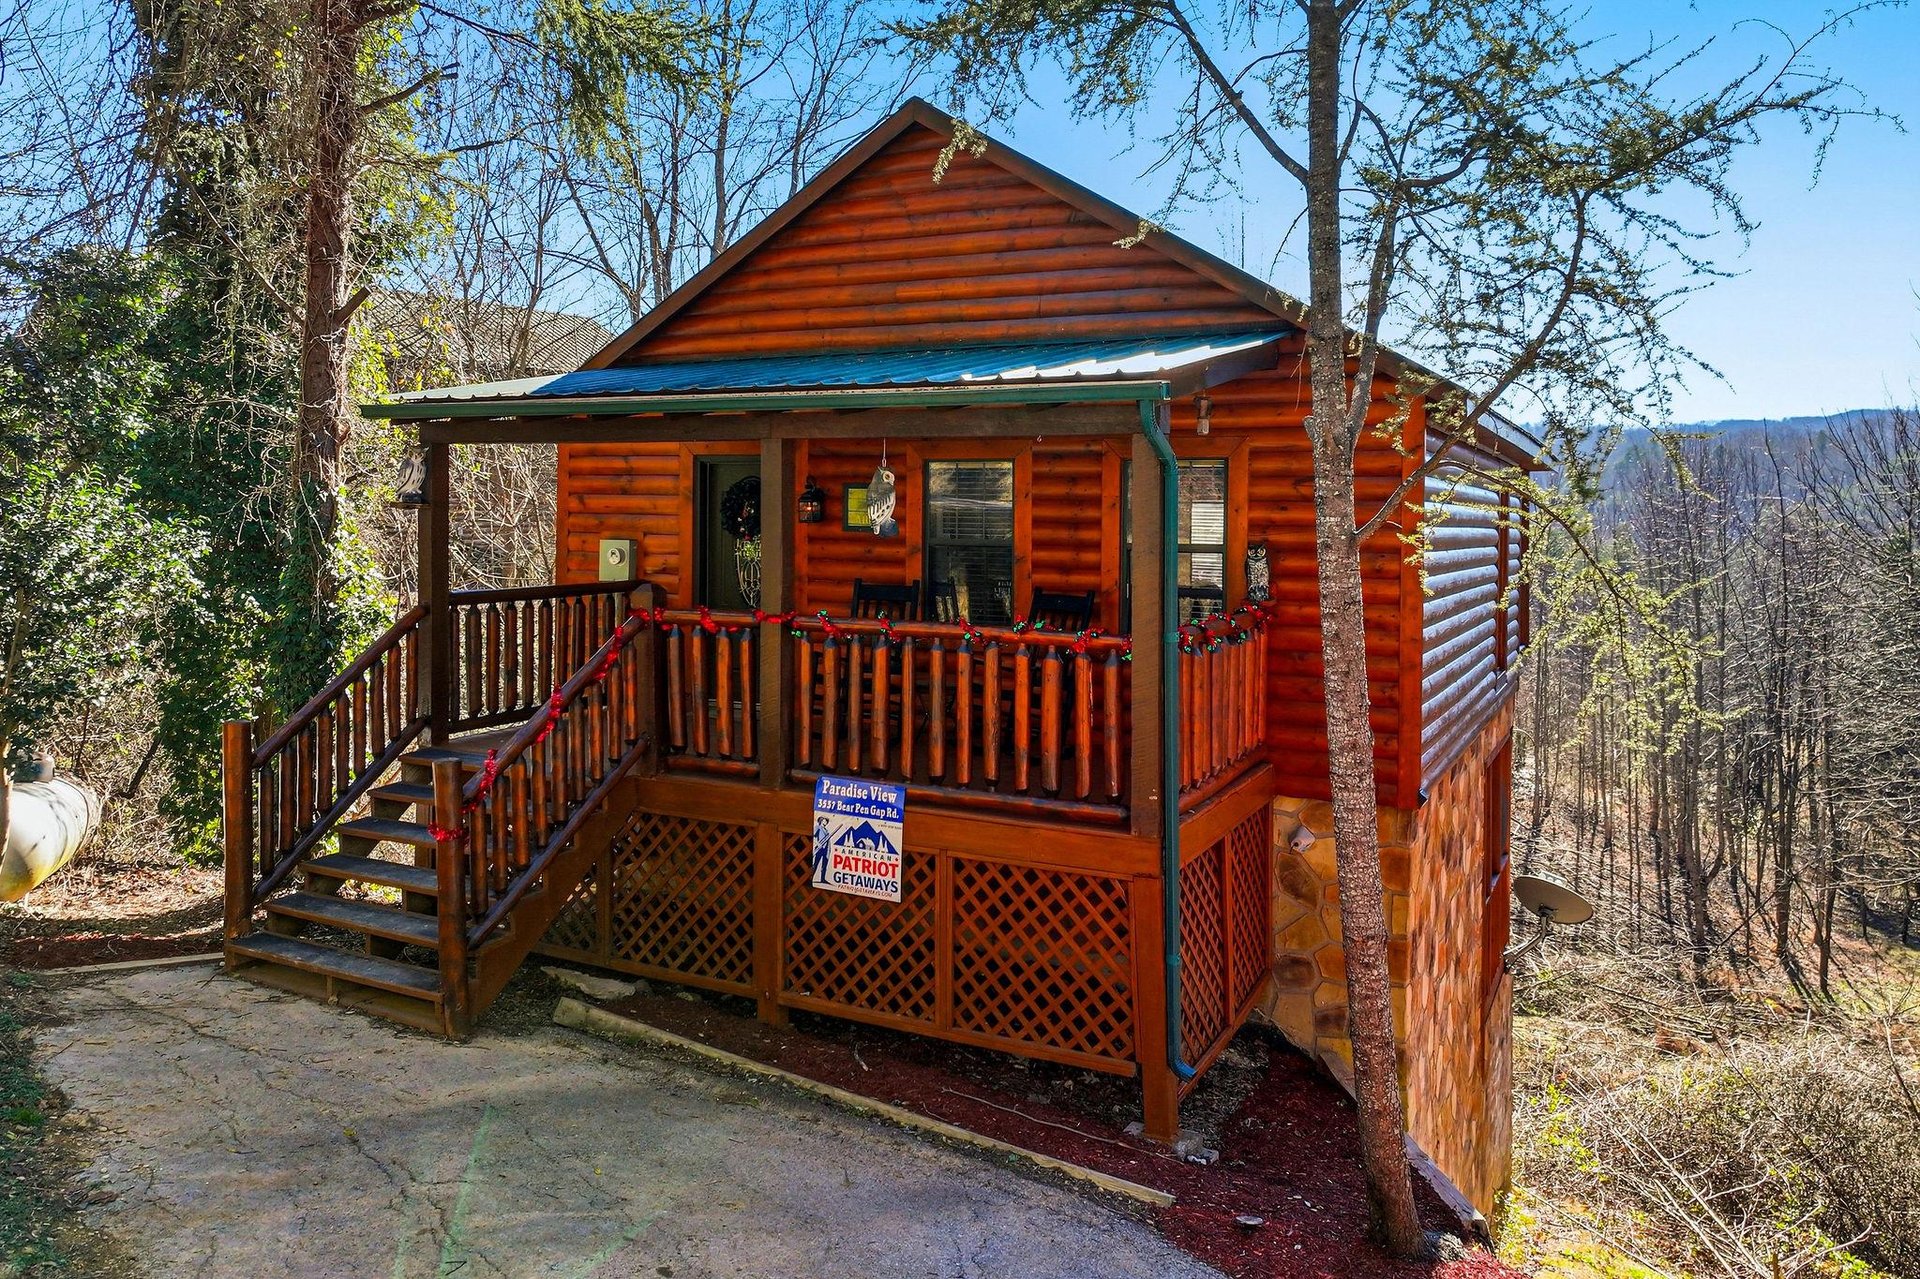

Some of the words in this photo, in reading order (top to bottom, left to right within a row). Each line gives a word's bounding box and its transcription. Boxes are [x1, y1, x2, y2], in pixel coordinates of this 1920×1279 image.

[822, 780, 868, 799] Paradise
[870, 785, 897, 804] View
[837, 800, 854, 813] Bear
[855, 803, 869, 815] Pen
[870, 805, 886, 819] Gap
[841, 848, 892, 861] AMERICAN
[833, 854, 899, 879] PATRIOT
[833, 871, 899, 893] GETAWAYS
